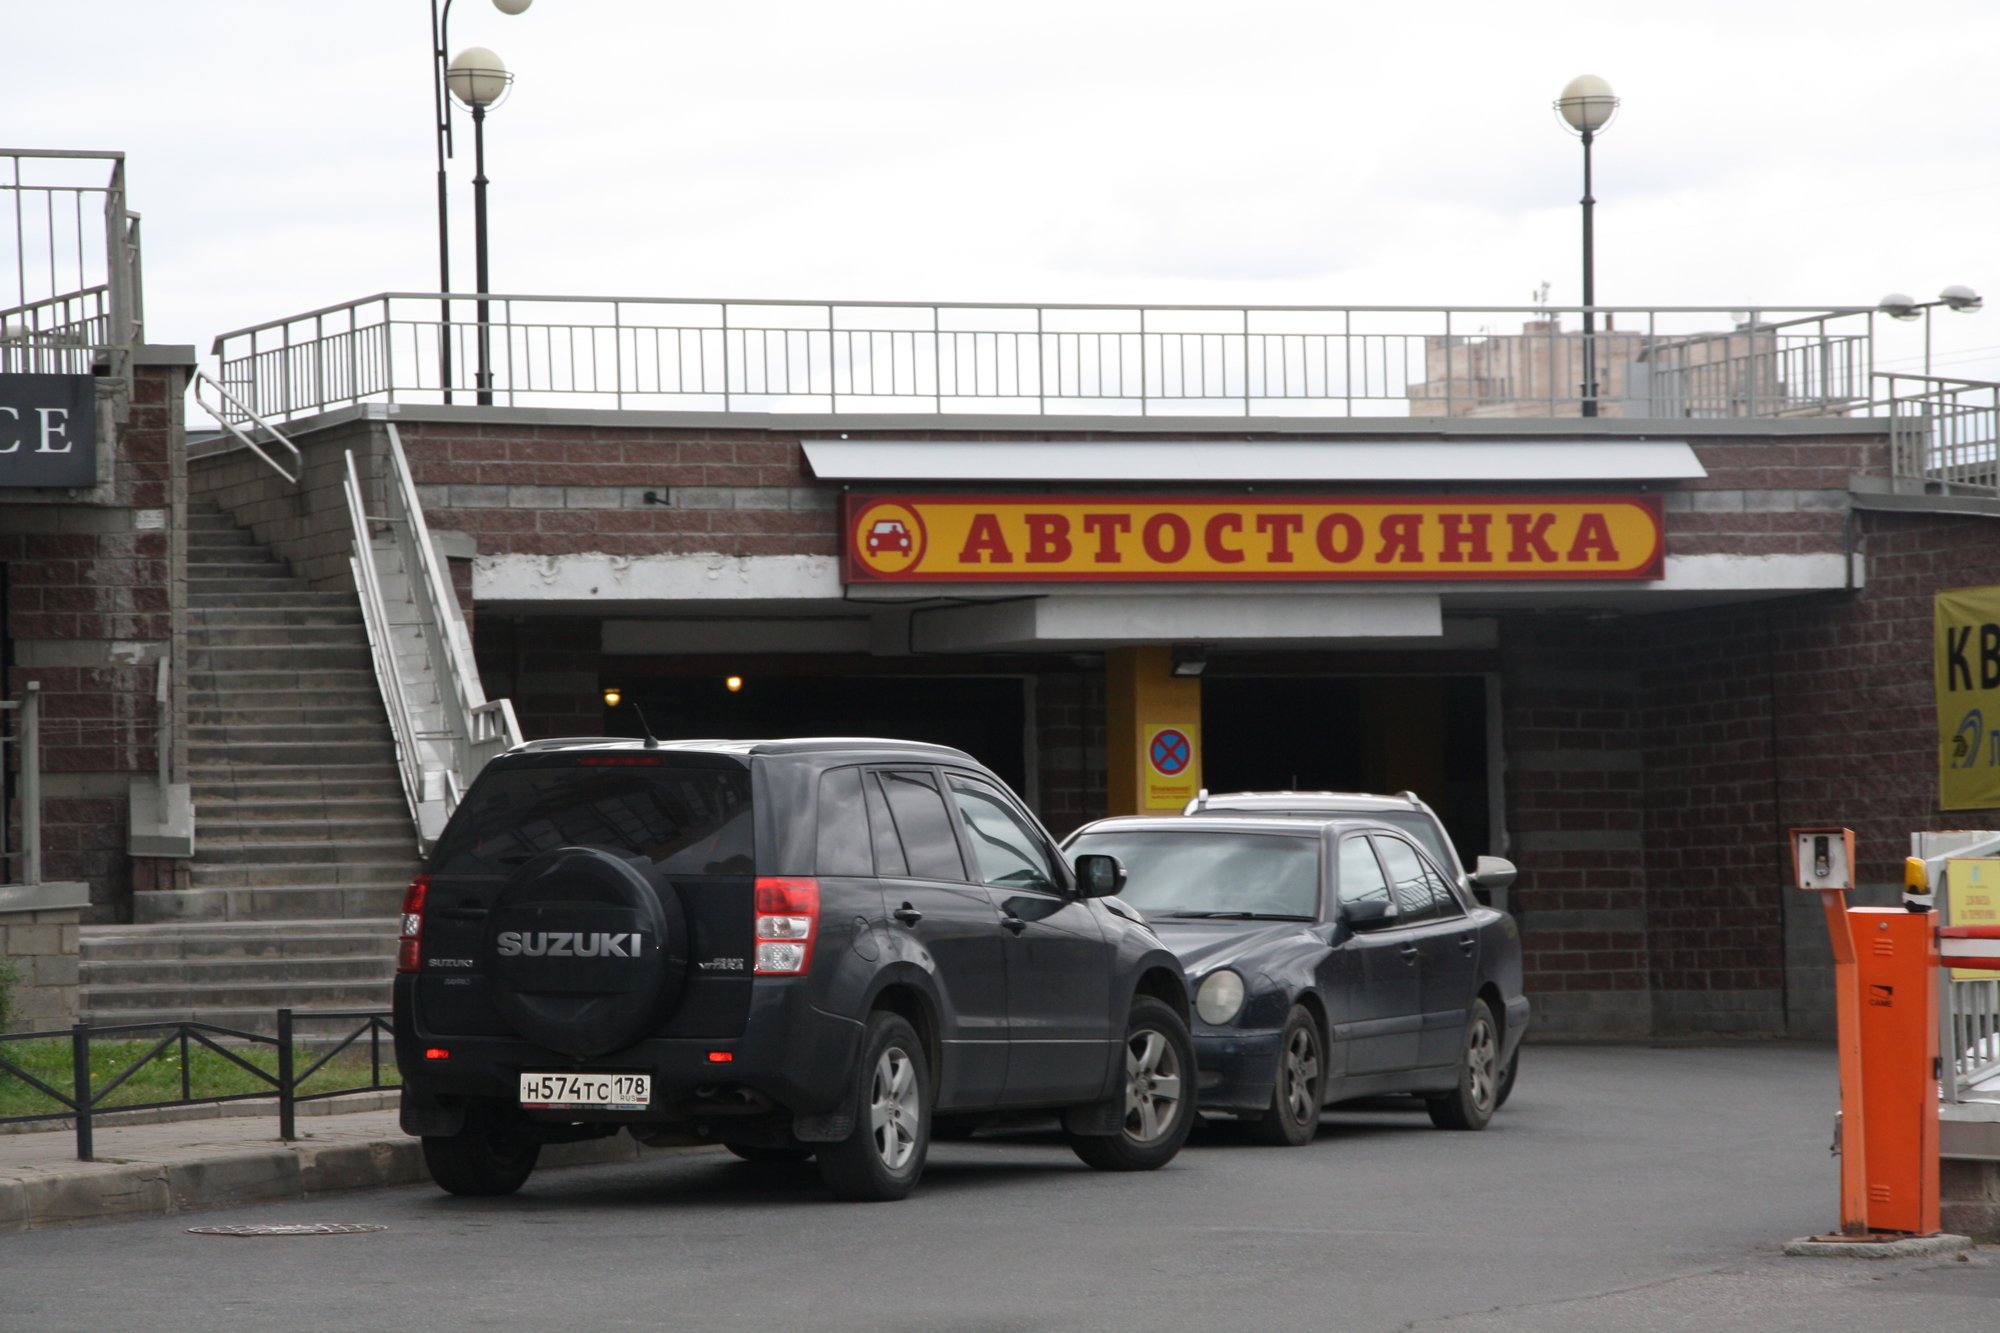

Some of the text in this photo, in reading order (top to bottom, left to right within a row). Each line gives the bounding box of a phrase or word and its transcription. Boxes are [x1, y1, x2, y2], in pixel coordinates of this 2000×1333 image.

[959, 512, 1620, 564] АВТОСТОЯНКА
[497, 931, 642, 958] SUZUKI
[428, 958, 474, 967] SUZUKI
[614, 1077, 644, 1095] 178
